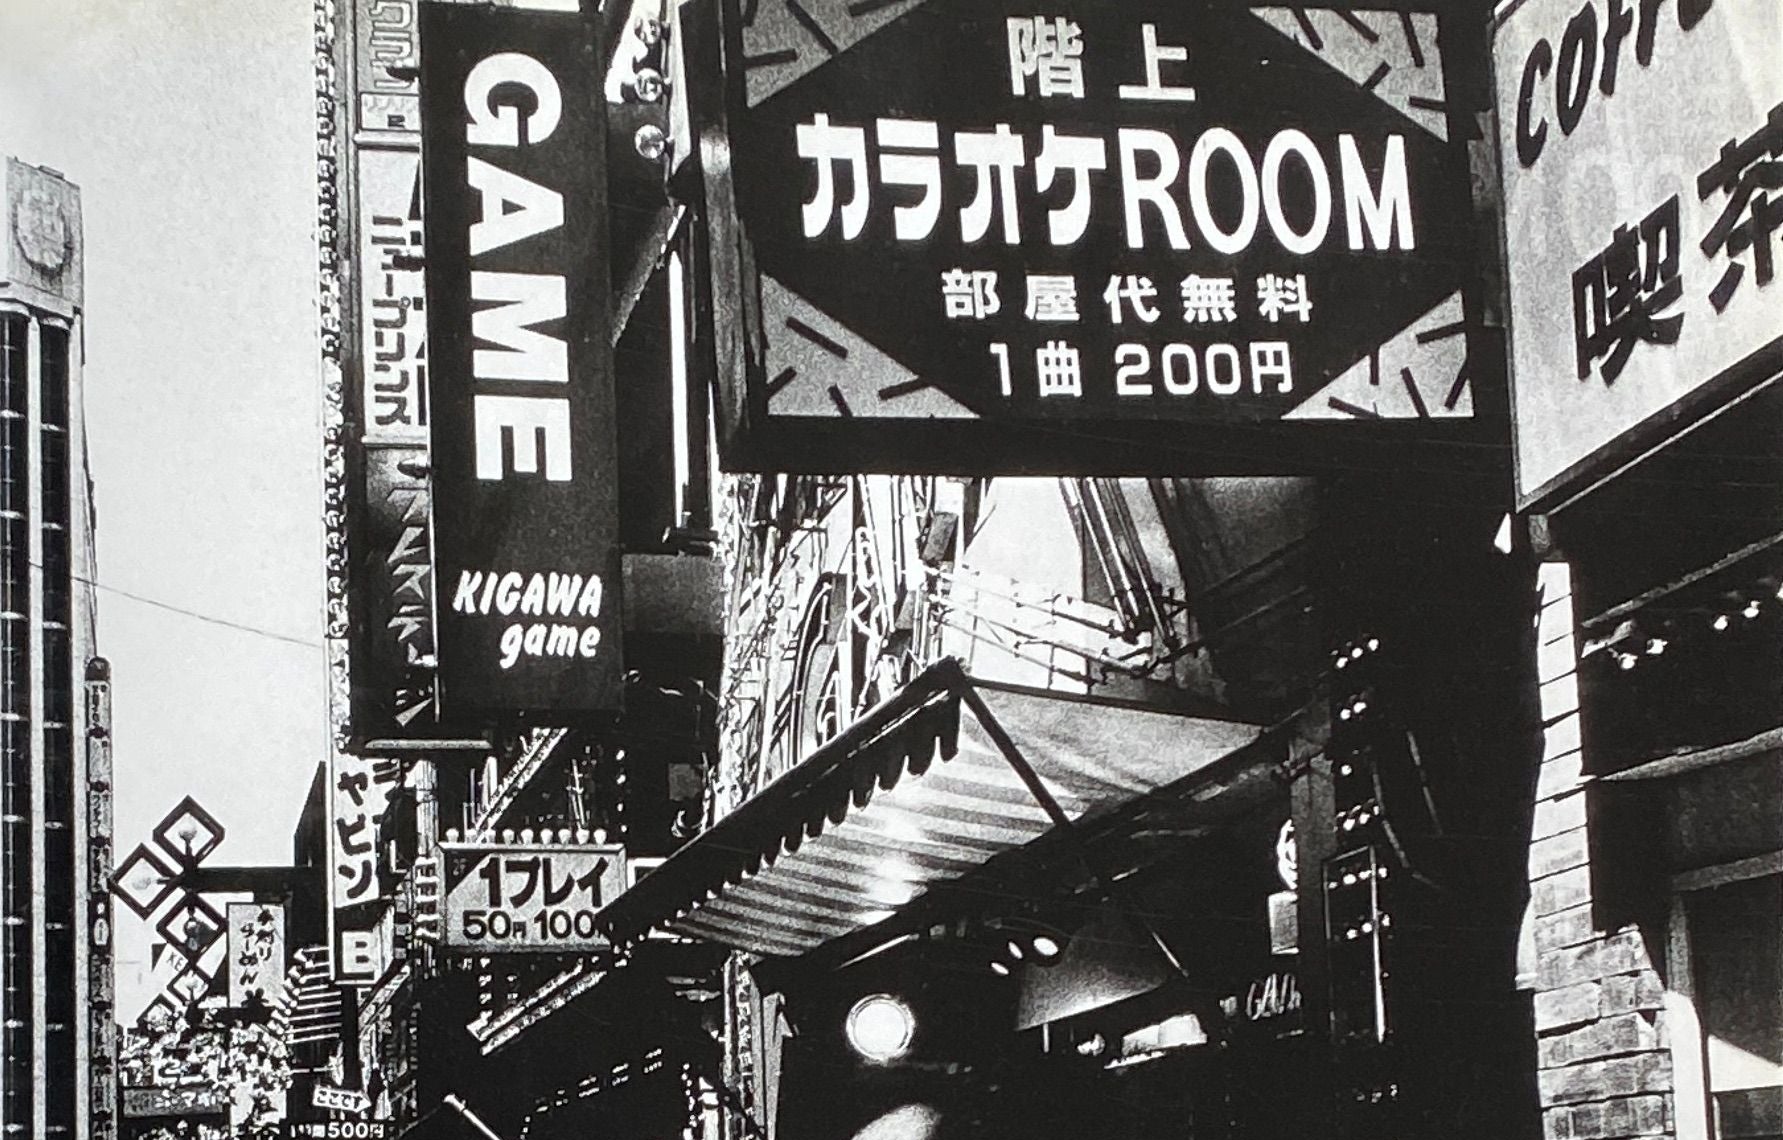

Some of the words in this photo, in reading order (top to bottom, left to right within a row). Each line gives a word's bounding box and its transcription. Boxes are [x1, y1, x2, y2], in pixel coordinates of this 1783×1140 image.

[1006, 16, 1197, 102] 階上
[1516, 0, 1712, 168] COF
[796, 113, 1415, 254] カラオケROOM
[463, 52, 573, 482] GAME
[941, 270, 1313, 323] 部屋代無料
[452, 569, 604, 619] KIGAWA
[499, 623, 602, 670] game
[479, 856, 609, 909] 1プレイ
